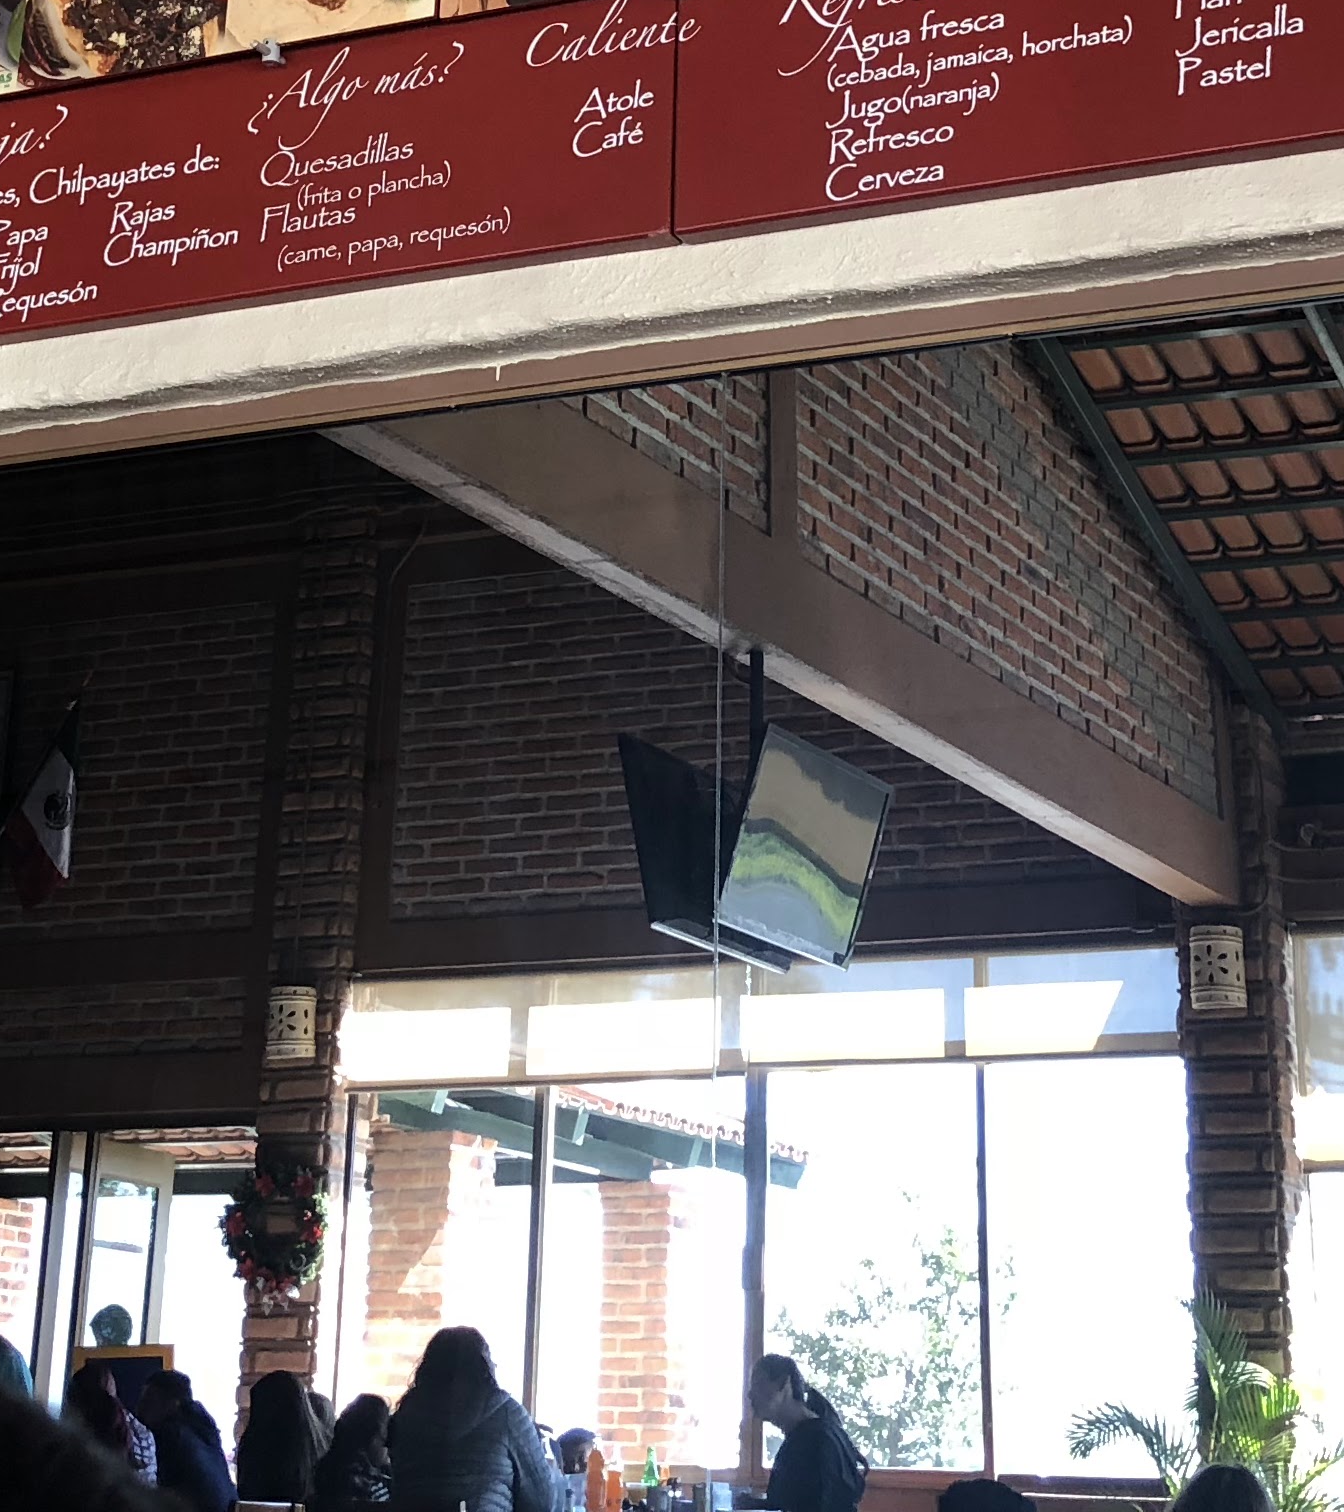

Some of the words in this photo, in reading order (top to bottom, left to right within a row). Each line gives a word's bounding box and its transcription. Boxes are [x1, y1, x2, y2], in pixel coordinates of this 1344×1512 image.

[827, 25, 910, 67] Agua
[920, 10, 1004, 41] fresca
[827, 52, 920, 92] (cebada,
[918, 44, 1013, 88] jamaica,
[1022, 15, 1132, 56] horchata)
[1175, 3, 1303, 57] Jericalla
[1178, 45, 1271, 95] Pastel
[248, 47, 369, 151] ¿Algo
[374, 41, 464, 94] más?
[574, 79, 654, 123] Atole
[260, 129, 413, 190] Quesadillas
[572, 116, 643, 157] Café
[829, 126, 954, 164] Refresco
[30, 161, 175, 206] Chilpayates
[183, 143, 219, 174] de:
[298, 183, 341, 211] (frita
[348, 187, 361, 199] o
[368, 160, 451, 207] plancha)
[826, 163, 944, 201] Cerveza
[104, 225, 238, 266] Champiñon
[110, 201, 175, 240] Rajas
[260, 203, 355, 242] Flautas
[348, 235, 403, 265] papa,
[410, 206, 510, 251] requesón)
